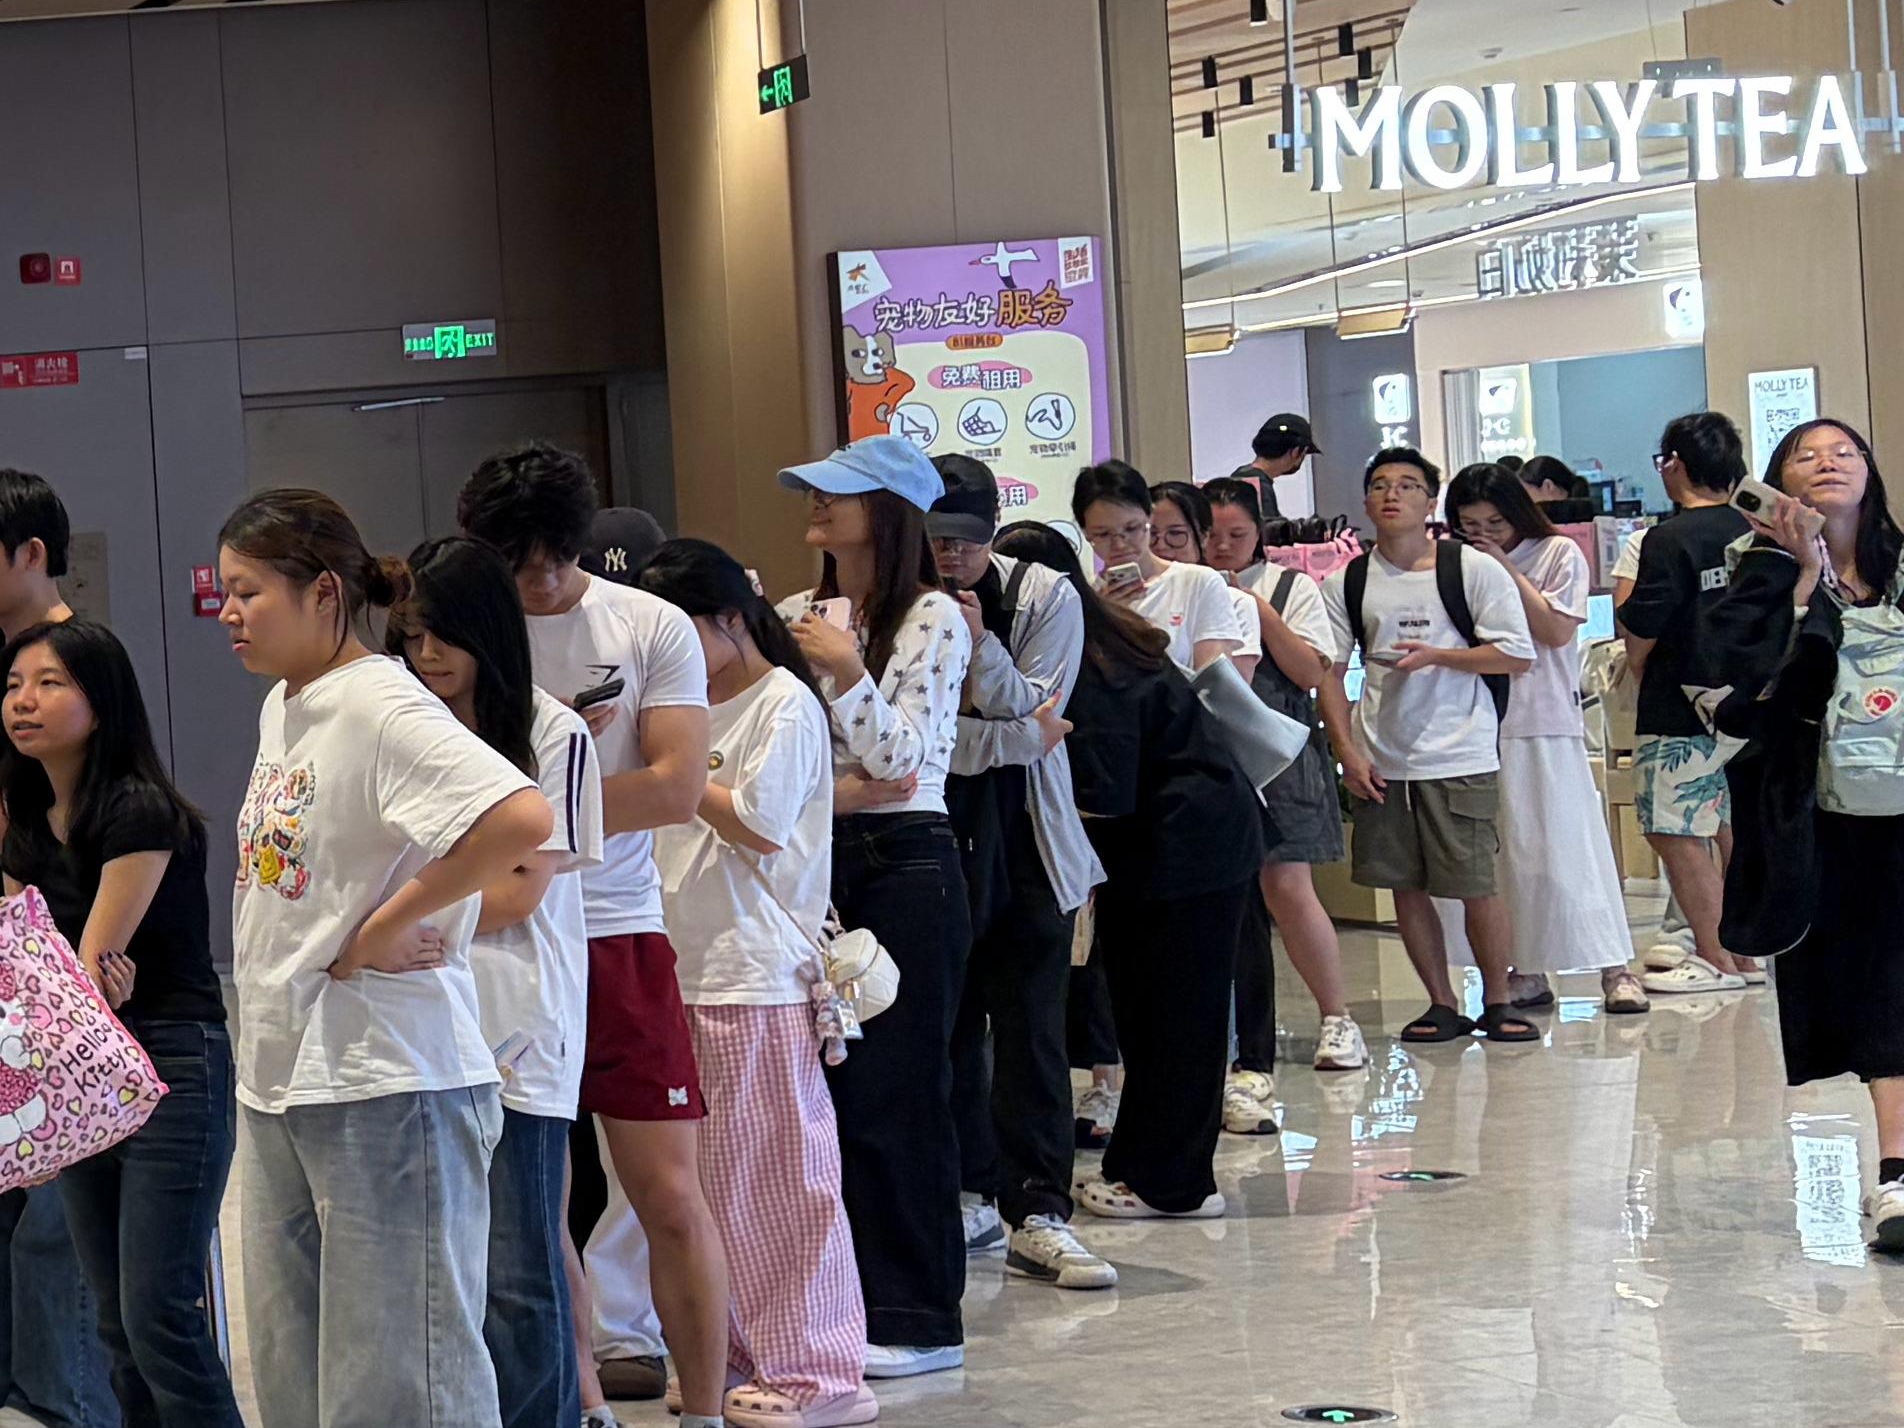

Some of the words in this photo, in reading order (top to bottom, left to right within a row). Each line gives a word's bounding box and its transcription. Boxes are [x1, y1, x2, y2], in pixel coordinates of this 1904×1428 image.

[1310, 79, 1658, 193] MOLLY
[1672, 74, 1868, 181] TEA
[874, 280, 1073, 332] 宠物友好服务
[465, 333, 494, 348] EXIT
[1754, 378, 1787, 393] MOLLY
[59, 1027, 108, 1075] Hello
[73, 1047, 128, 1097] Kitty
